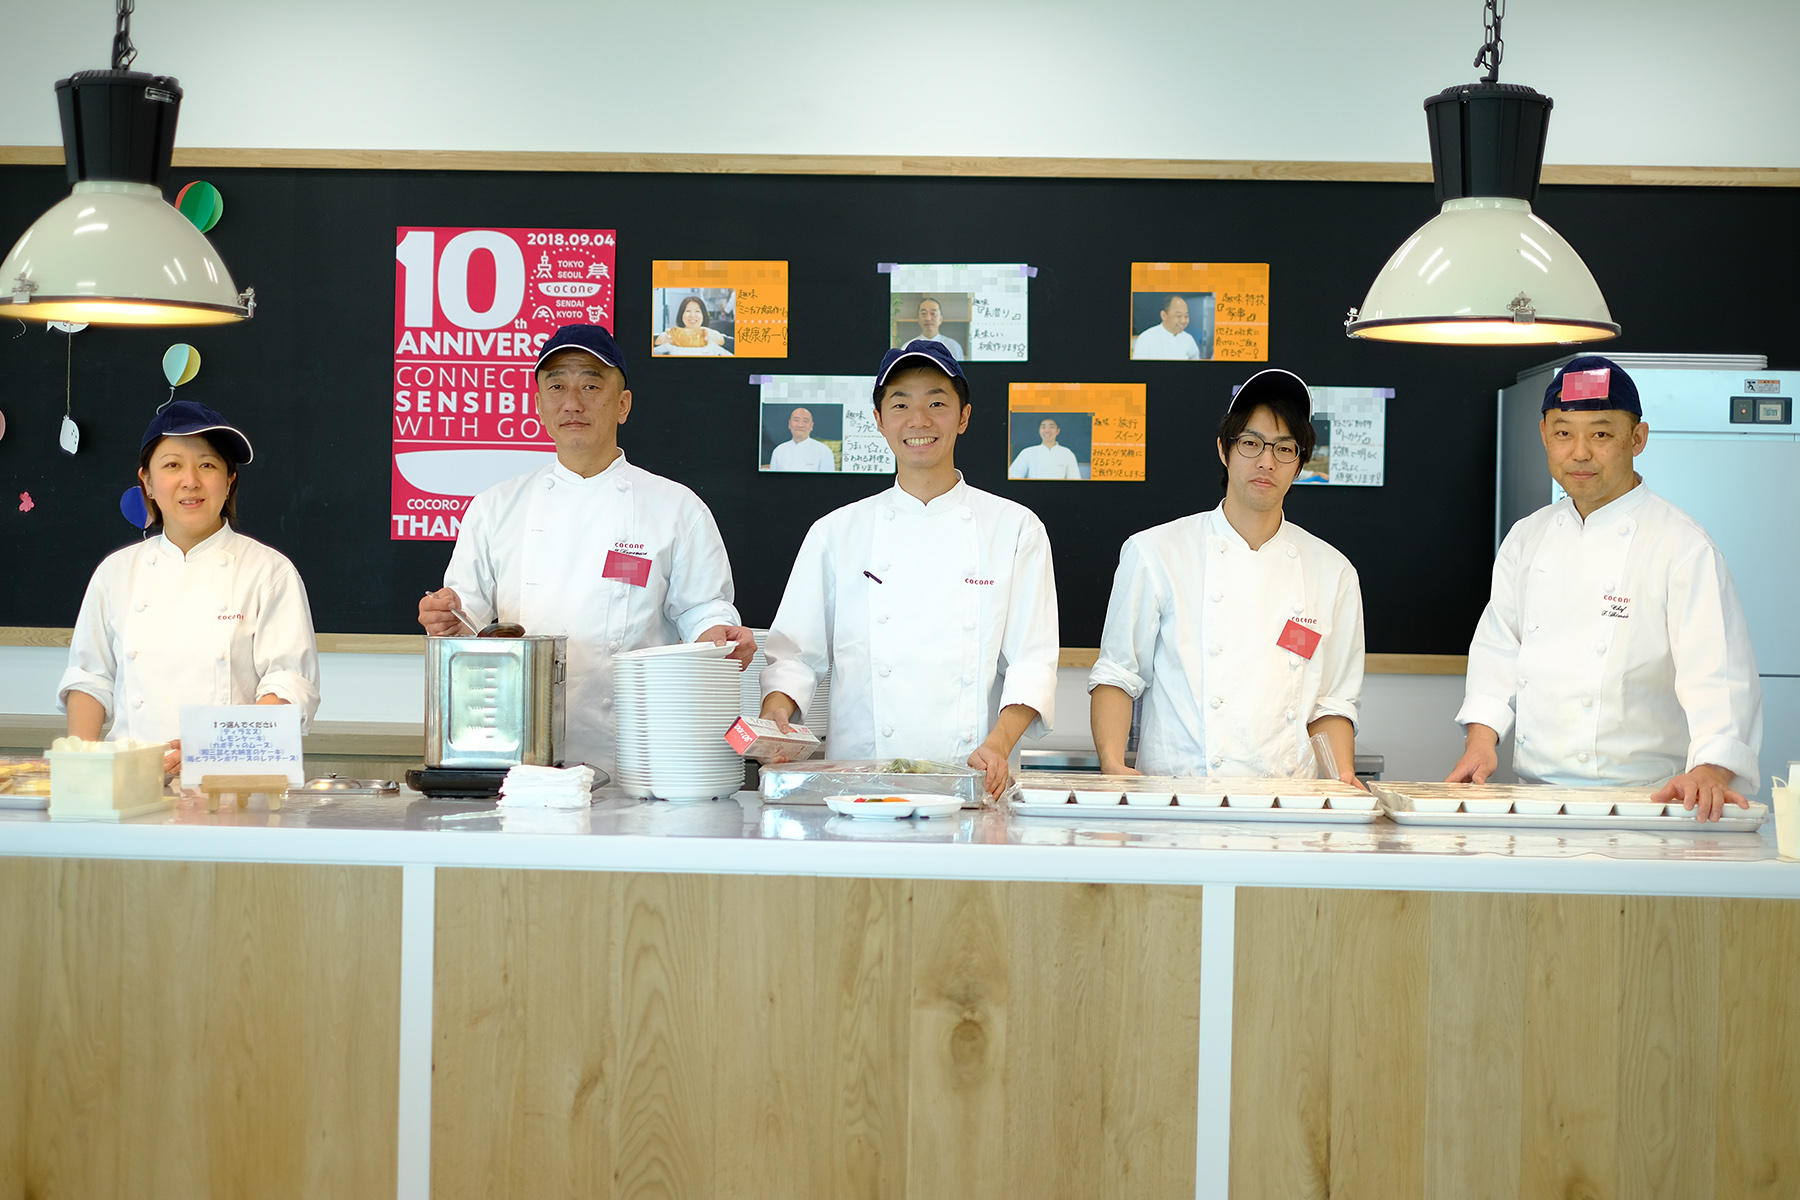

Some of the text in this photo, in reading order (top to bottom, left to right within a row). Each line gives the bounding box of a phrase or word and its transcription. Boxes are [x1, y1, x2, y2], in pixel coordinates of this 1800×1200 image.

[527, 233, 615, 246] 2018.09.04
[557, 260, 584, 268] TOKYO
[557, 271, 583, 279] SEOUL
[546, 285, 593, 293] cocone
[556, 310, 583, 318] KYOTO
[396, 331, 550, 356] ANNIVERS
[395, 391, 538, 414] SENSIBI
[396, 416, 479, 438] WITH
